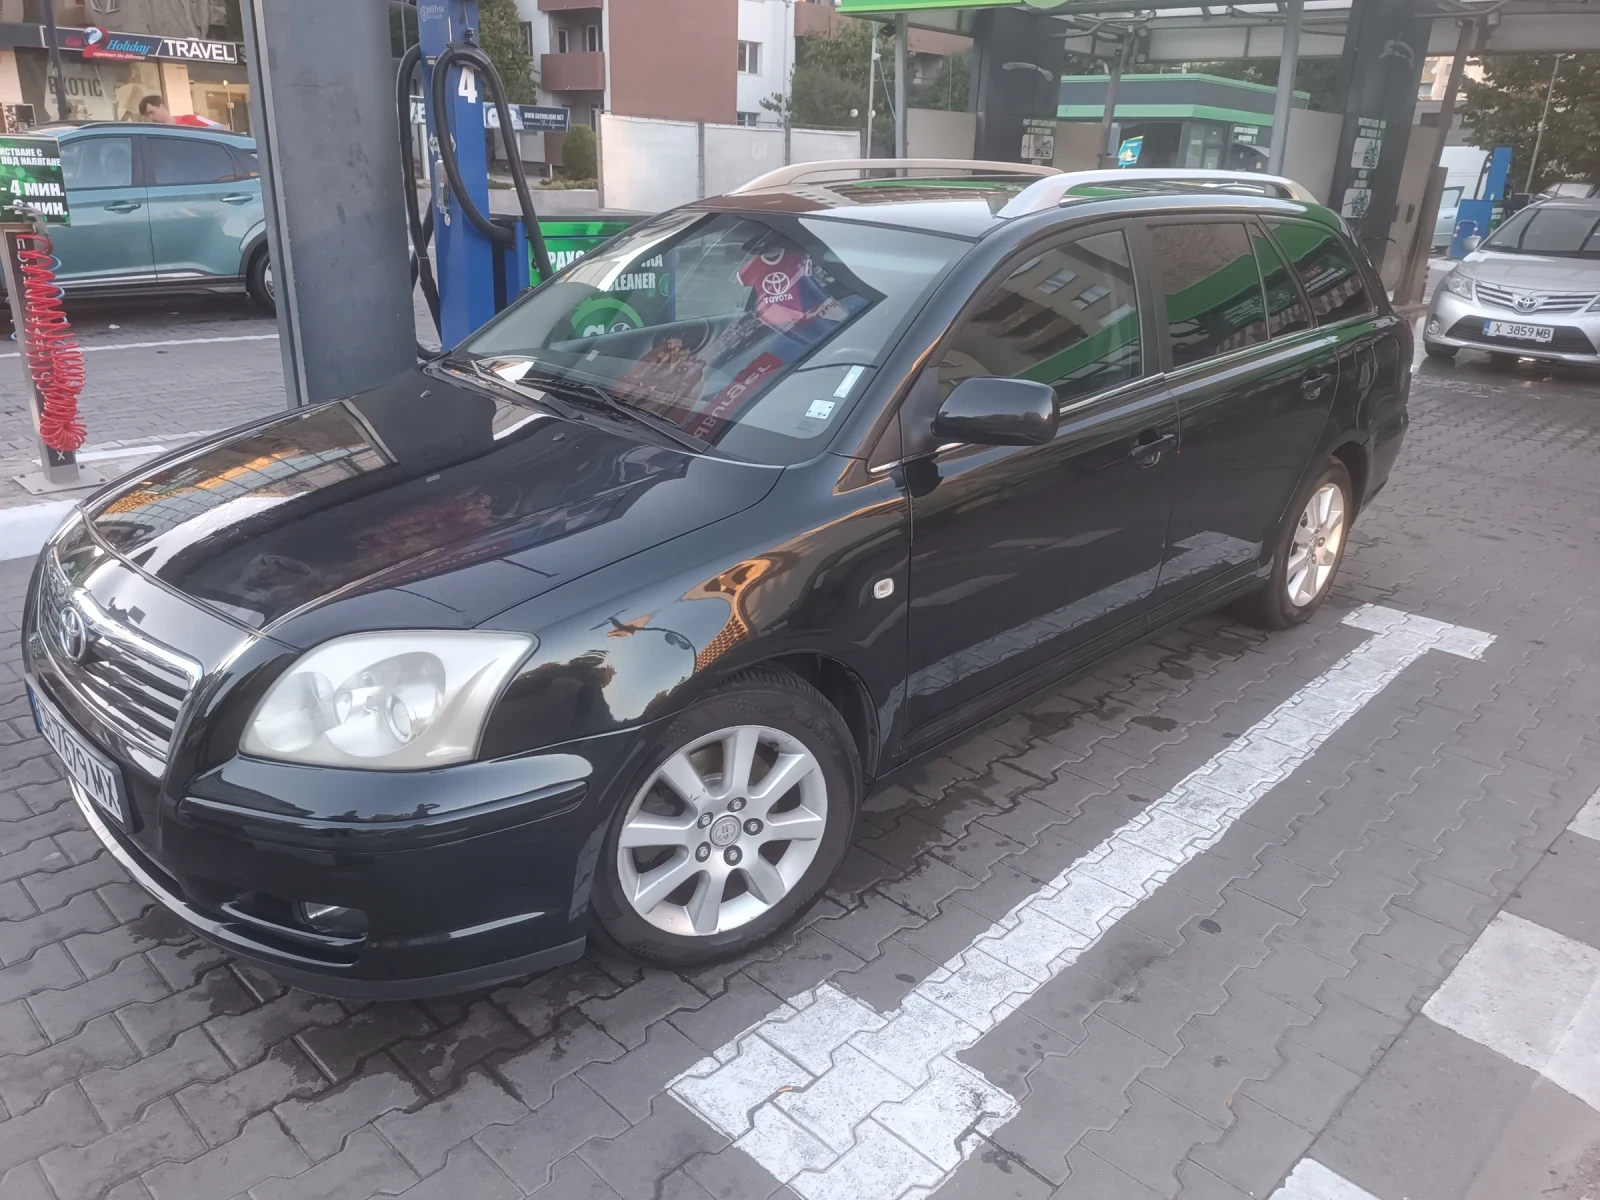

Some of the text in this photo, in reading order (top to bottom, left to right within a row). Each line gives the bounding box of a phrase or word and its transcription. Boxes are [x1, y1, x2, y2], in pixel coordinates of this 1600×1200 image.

[107, 40, 150, 54] Holiday
[164, 39, 235, 61] TRAVEL
[458, 66, 477, 104] 4
[1, 156, 61, 167] ПОД НАЛЯГАНЕ
[10, 180, 22, 196] 4
[24, 182, 65, 196] МИН.
[763, 293, 793, 304] TOYOTA
[1494, 323, 1551, 339] X 3859 MB
[89, 756, 121, 816] MX
